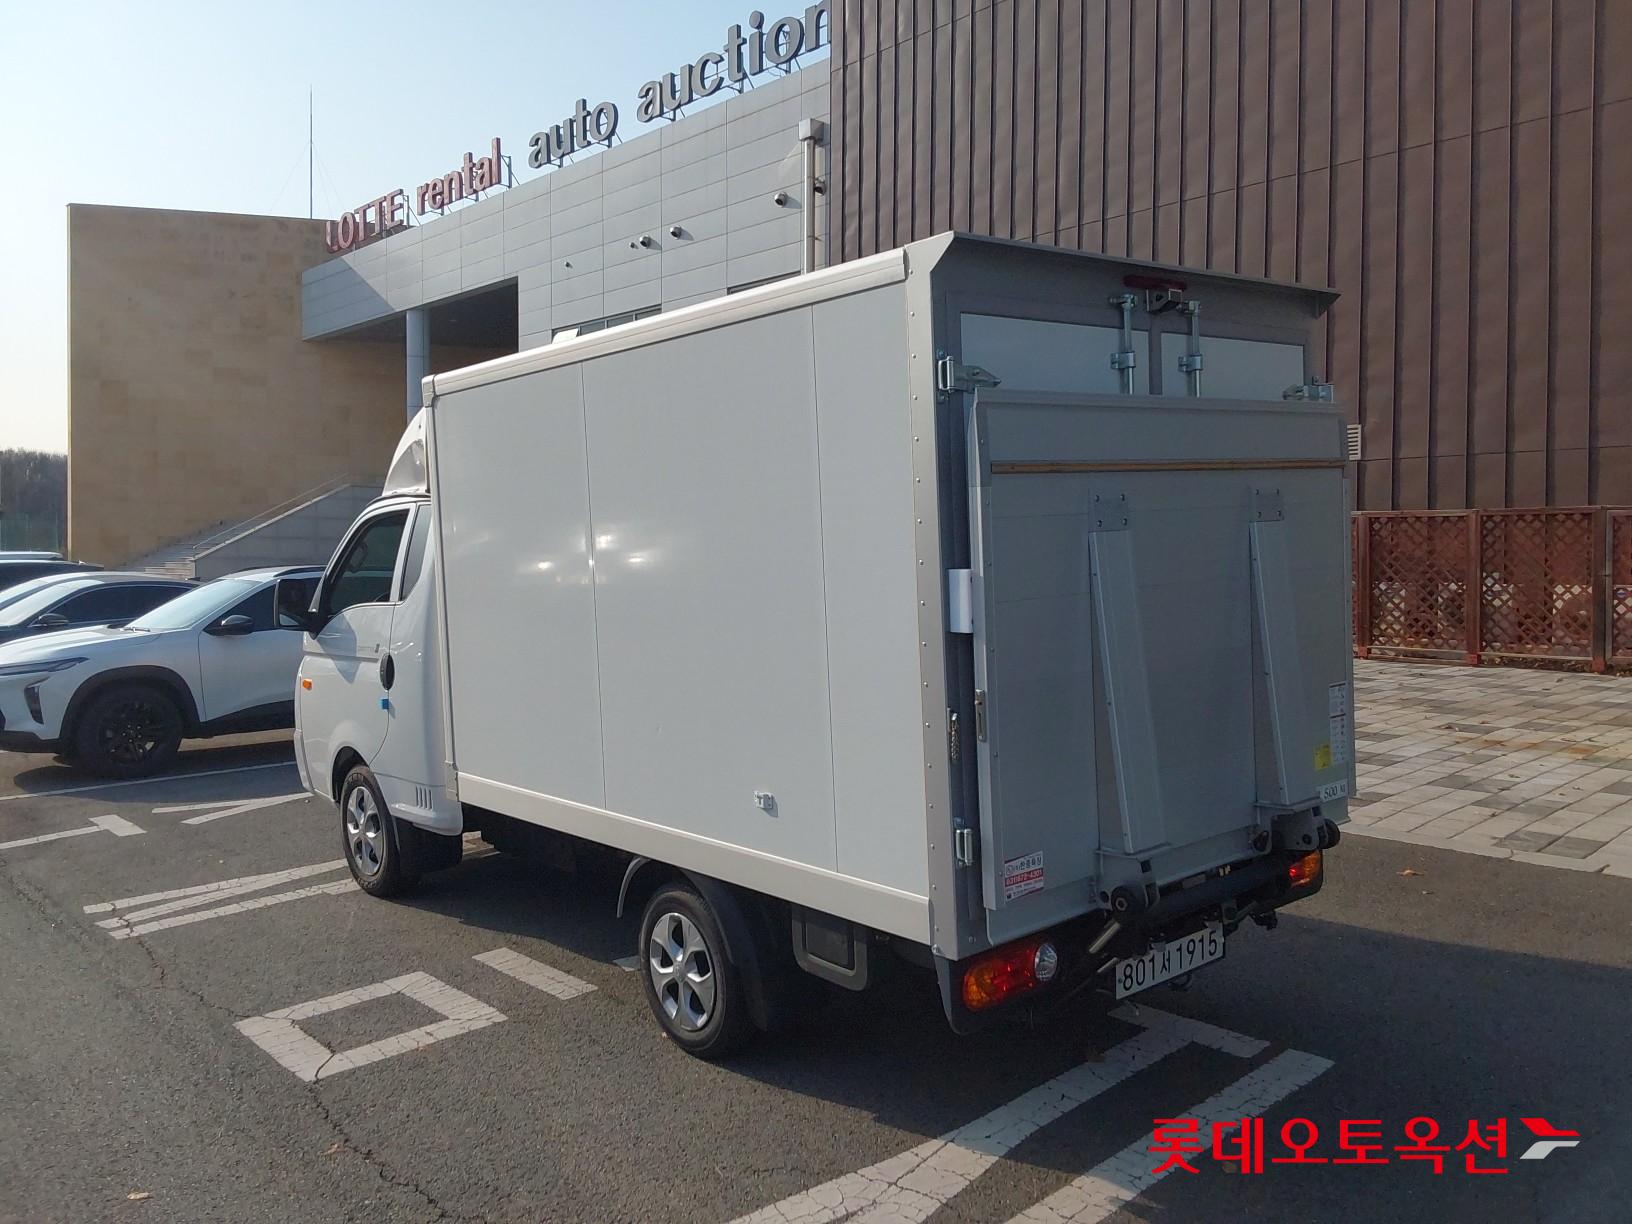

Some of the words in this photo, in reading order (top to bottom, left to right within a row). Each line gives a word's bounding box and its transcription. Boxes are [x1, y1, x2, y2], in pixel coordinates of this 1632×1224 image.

[325, 188, 405, 253] LOTTE
[416, 137, 502, 216] rental
[528, 98, 619, 169] auto
[636, 0, 831, 123] auction
